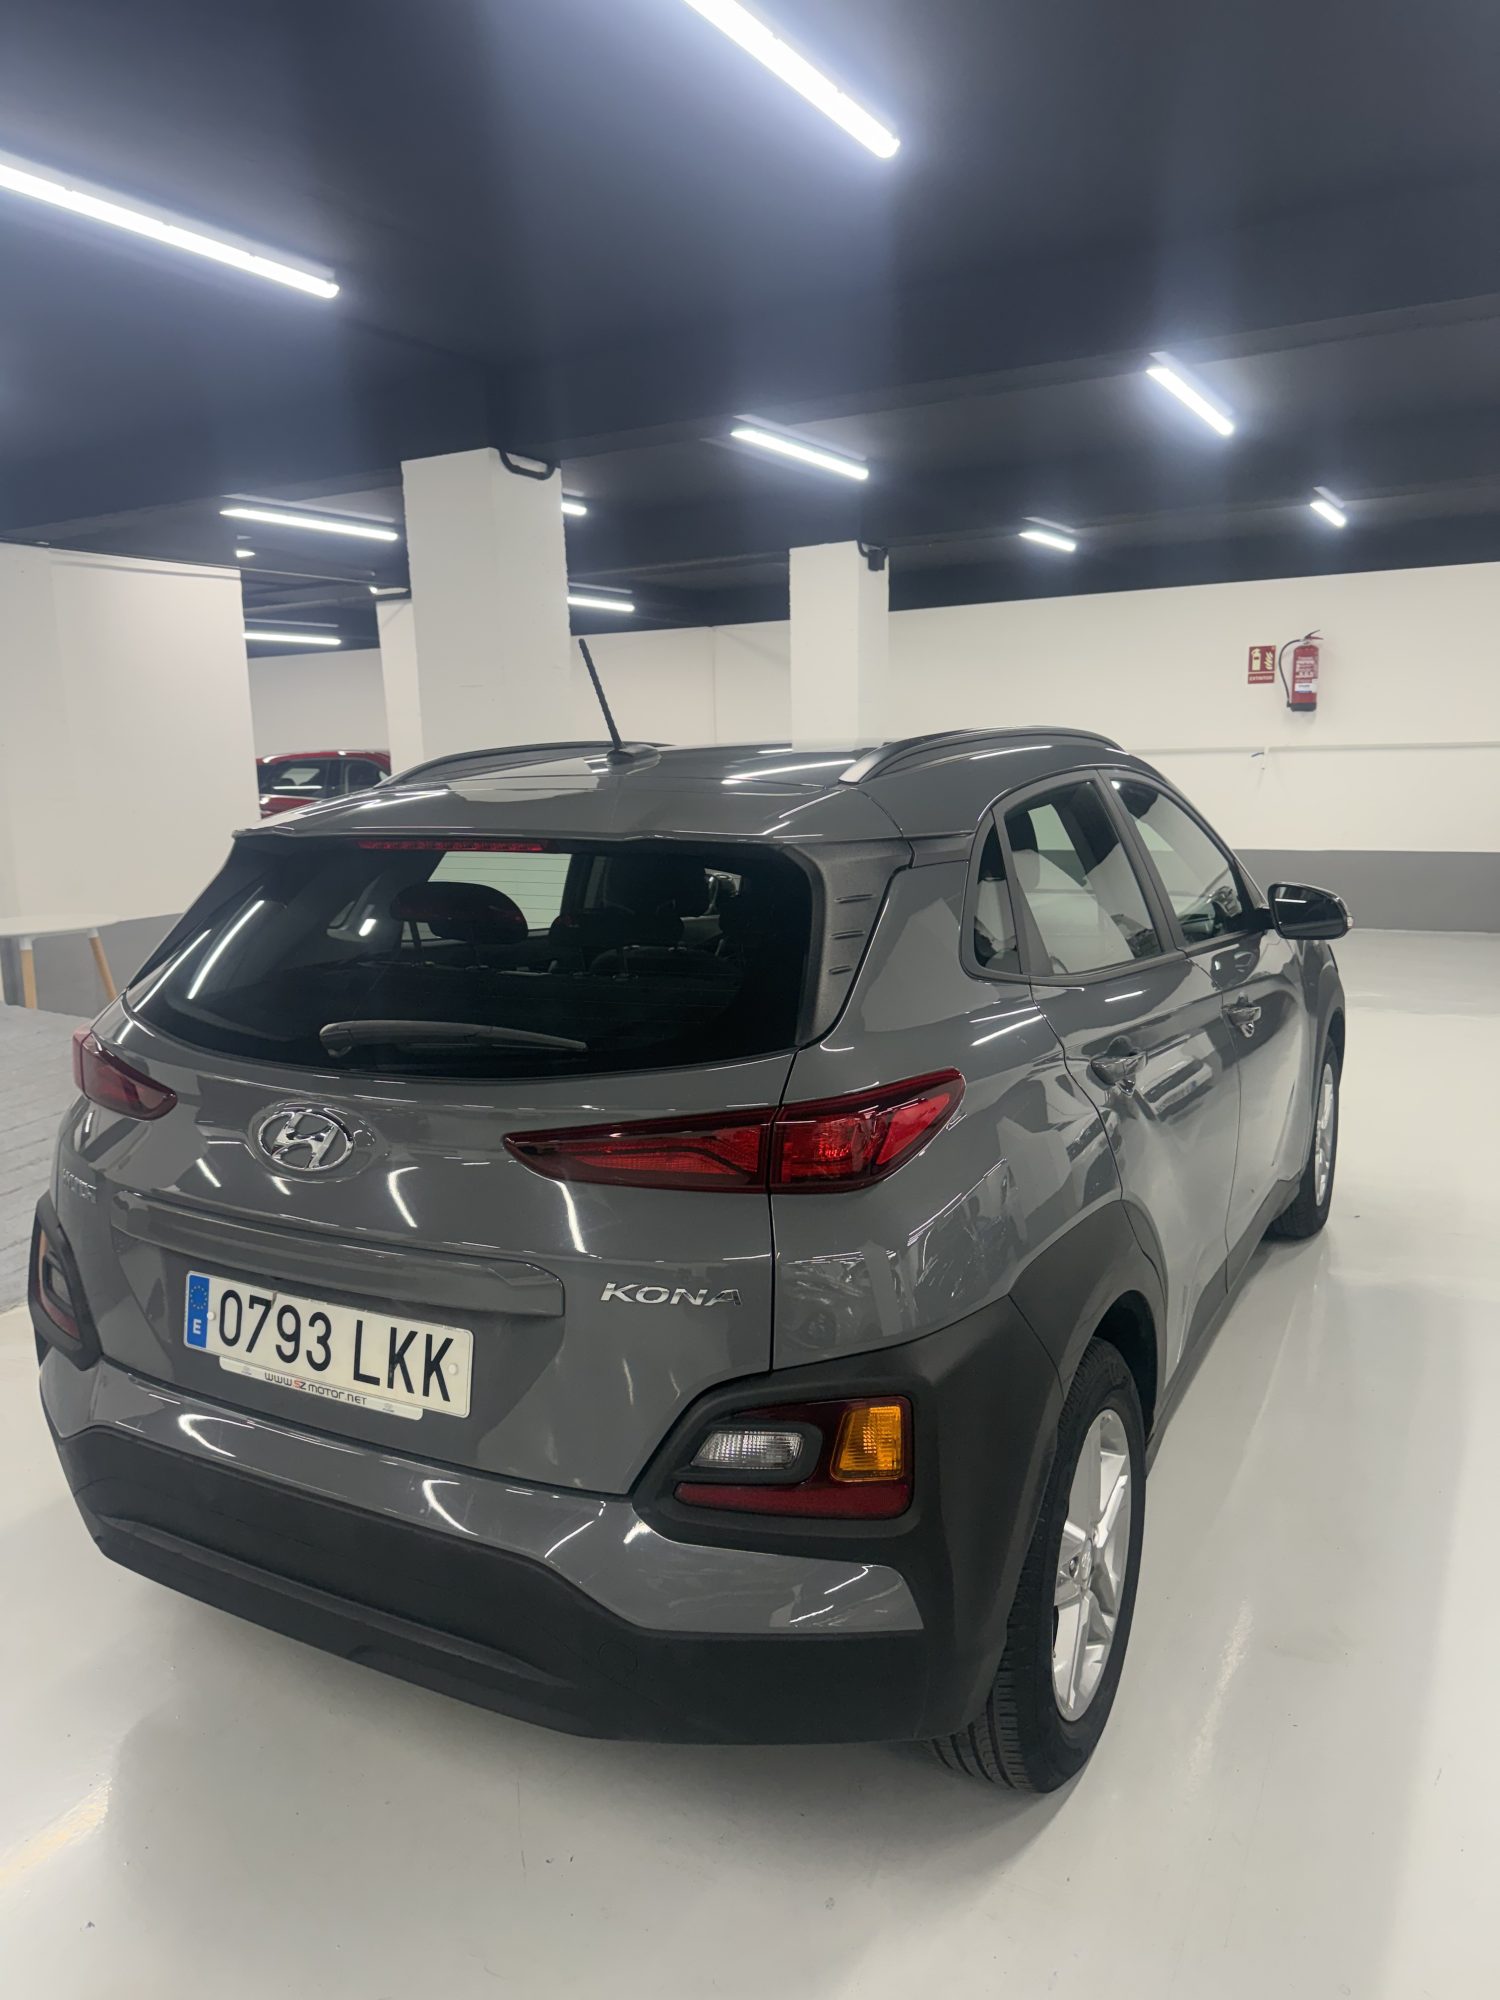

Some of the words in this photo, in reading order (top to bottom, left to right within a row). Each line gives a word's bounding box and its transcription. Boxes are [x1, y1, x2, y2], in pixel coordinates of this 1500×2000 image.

[600, 1282, 742, 1307] KONA
[192, 1319, 202, 1335] E
[219, 1289, 332, 1372] 0793
[353, 1319, 454, 1402] LKK
